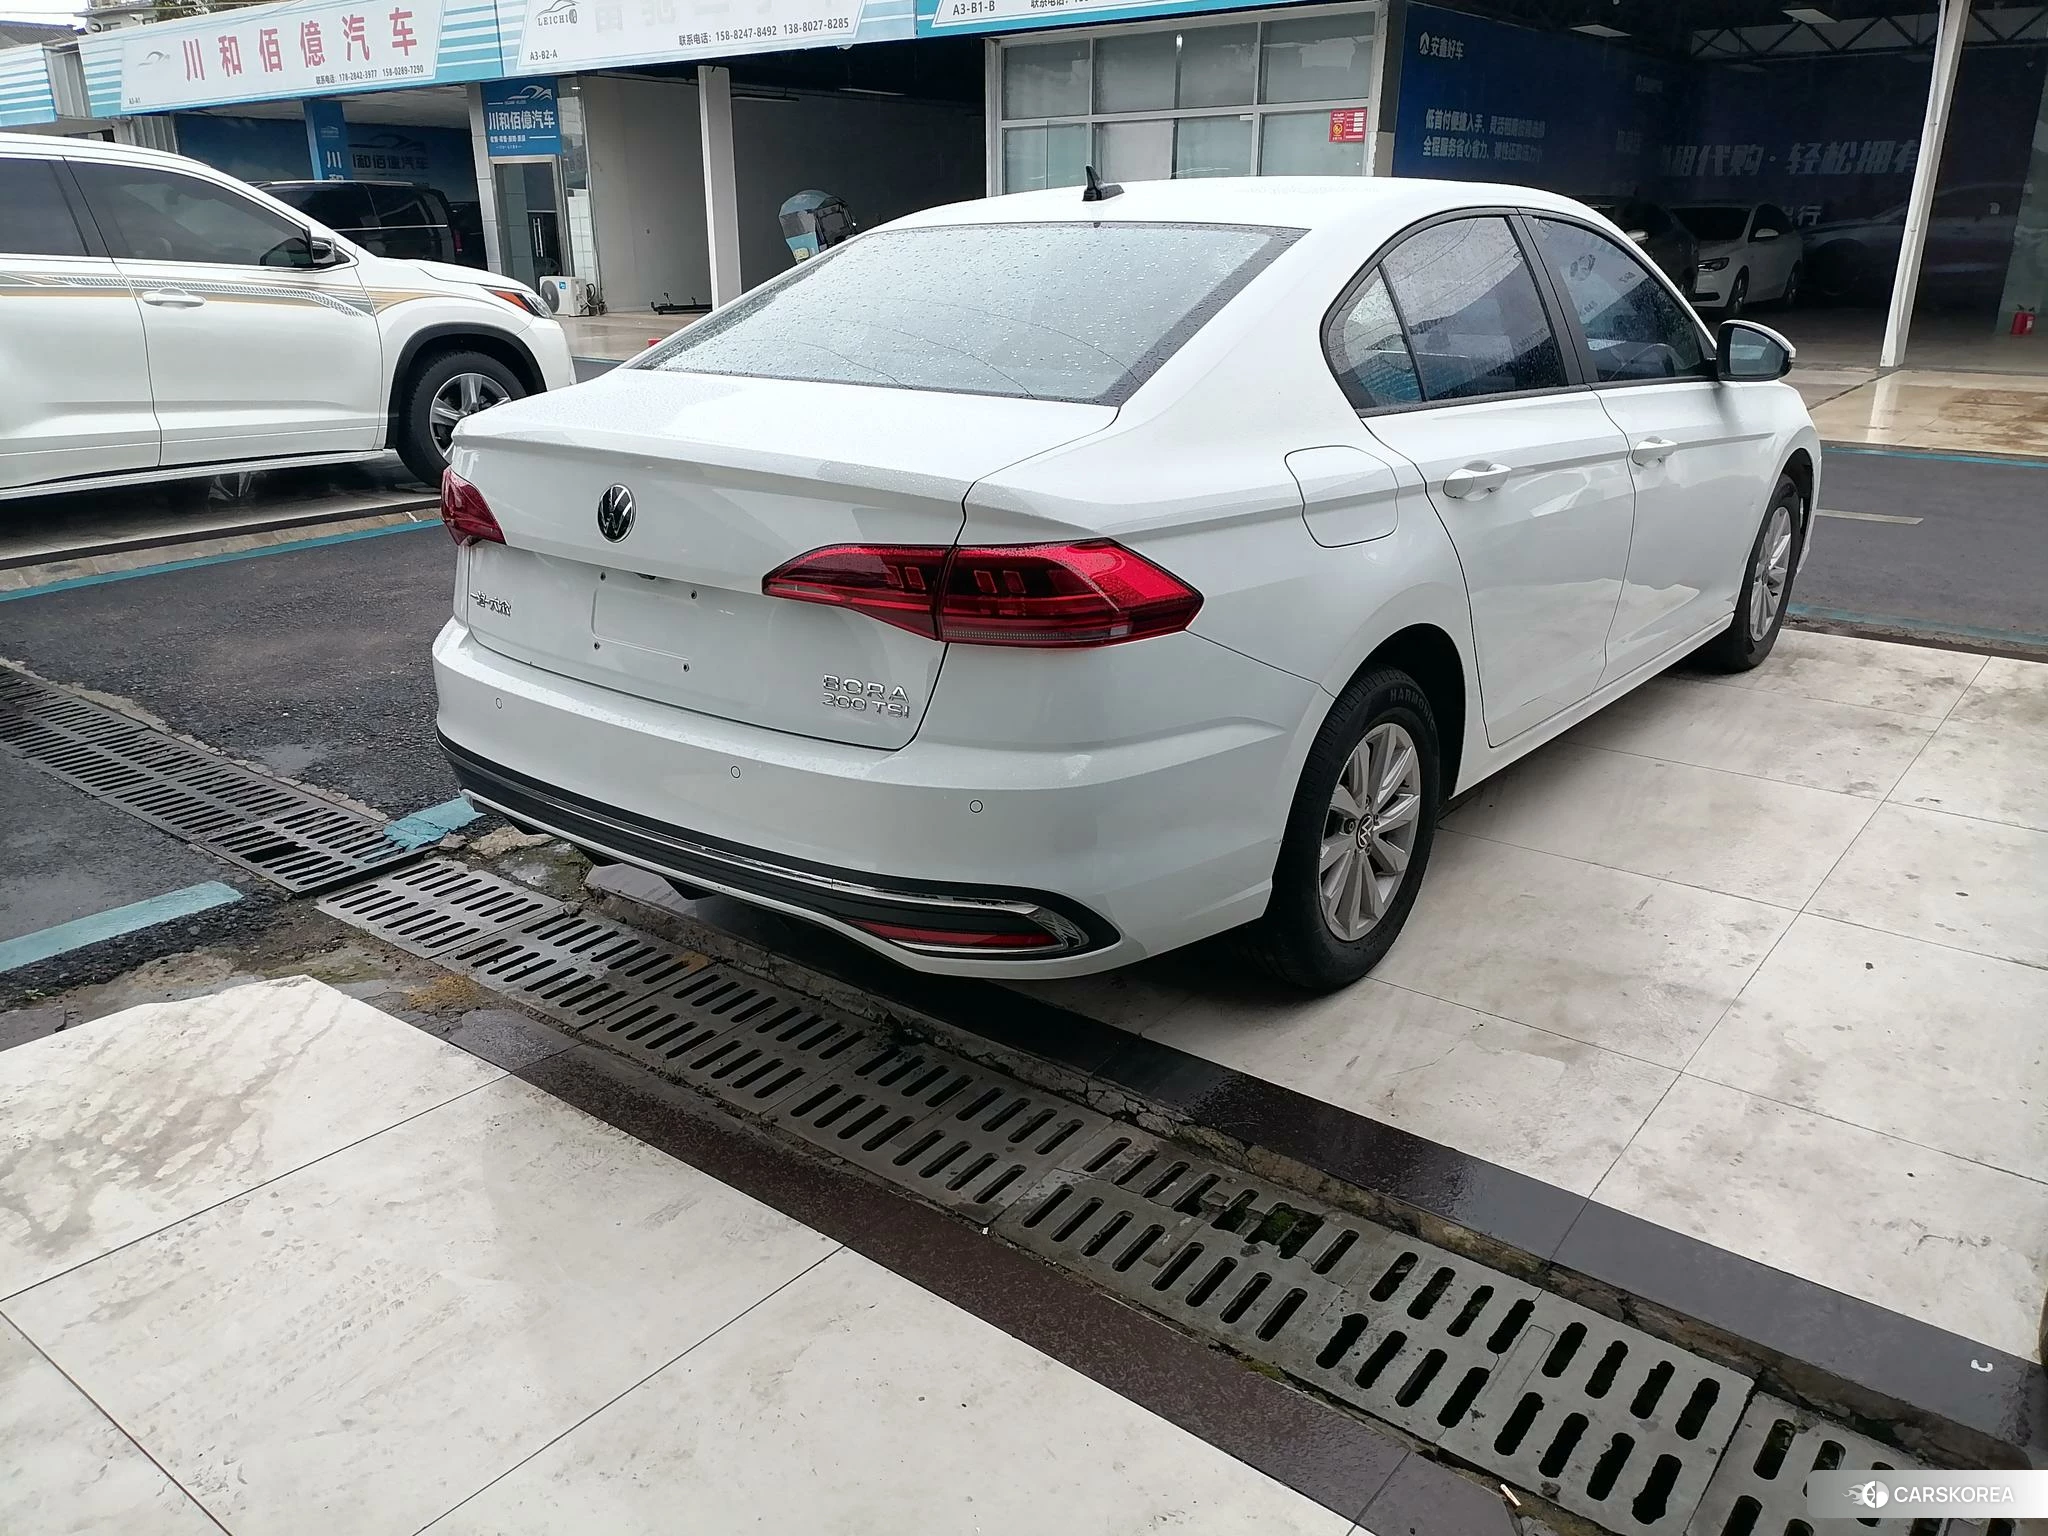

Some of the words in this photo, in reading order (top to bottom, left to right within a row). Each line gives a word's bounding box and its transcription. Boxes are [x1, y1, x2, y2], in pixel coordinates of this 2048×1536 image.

[952, 3, 996, 16] A3-B1-B
[716, 25, 777, 42] 158-8247-8492
[783, 18, 849, 35] 138-8027-8285
[182, 7, 418, 82] 川和佰億汽车
[530, 49, 558, 61] A3-B2-A
[488, 109, 556, 131] 川和佰億汽车
[823, 674, 909, 703] BORA
[822, 692, 867, 711] 200
[871, 700, 910, 718] TSI
